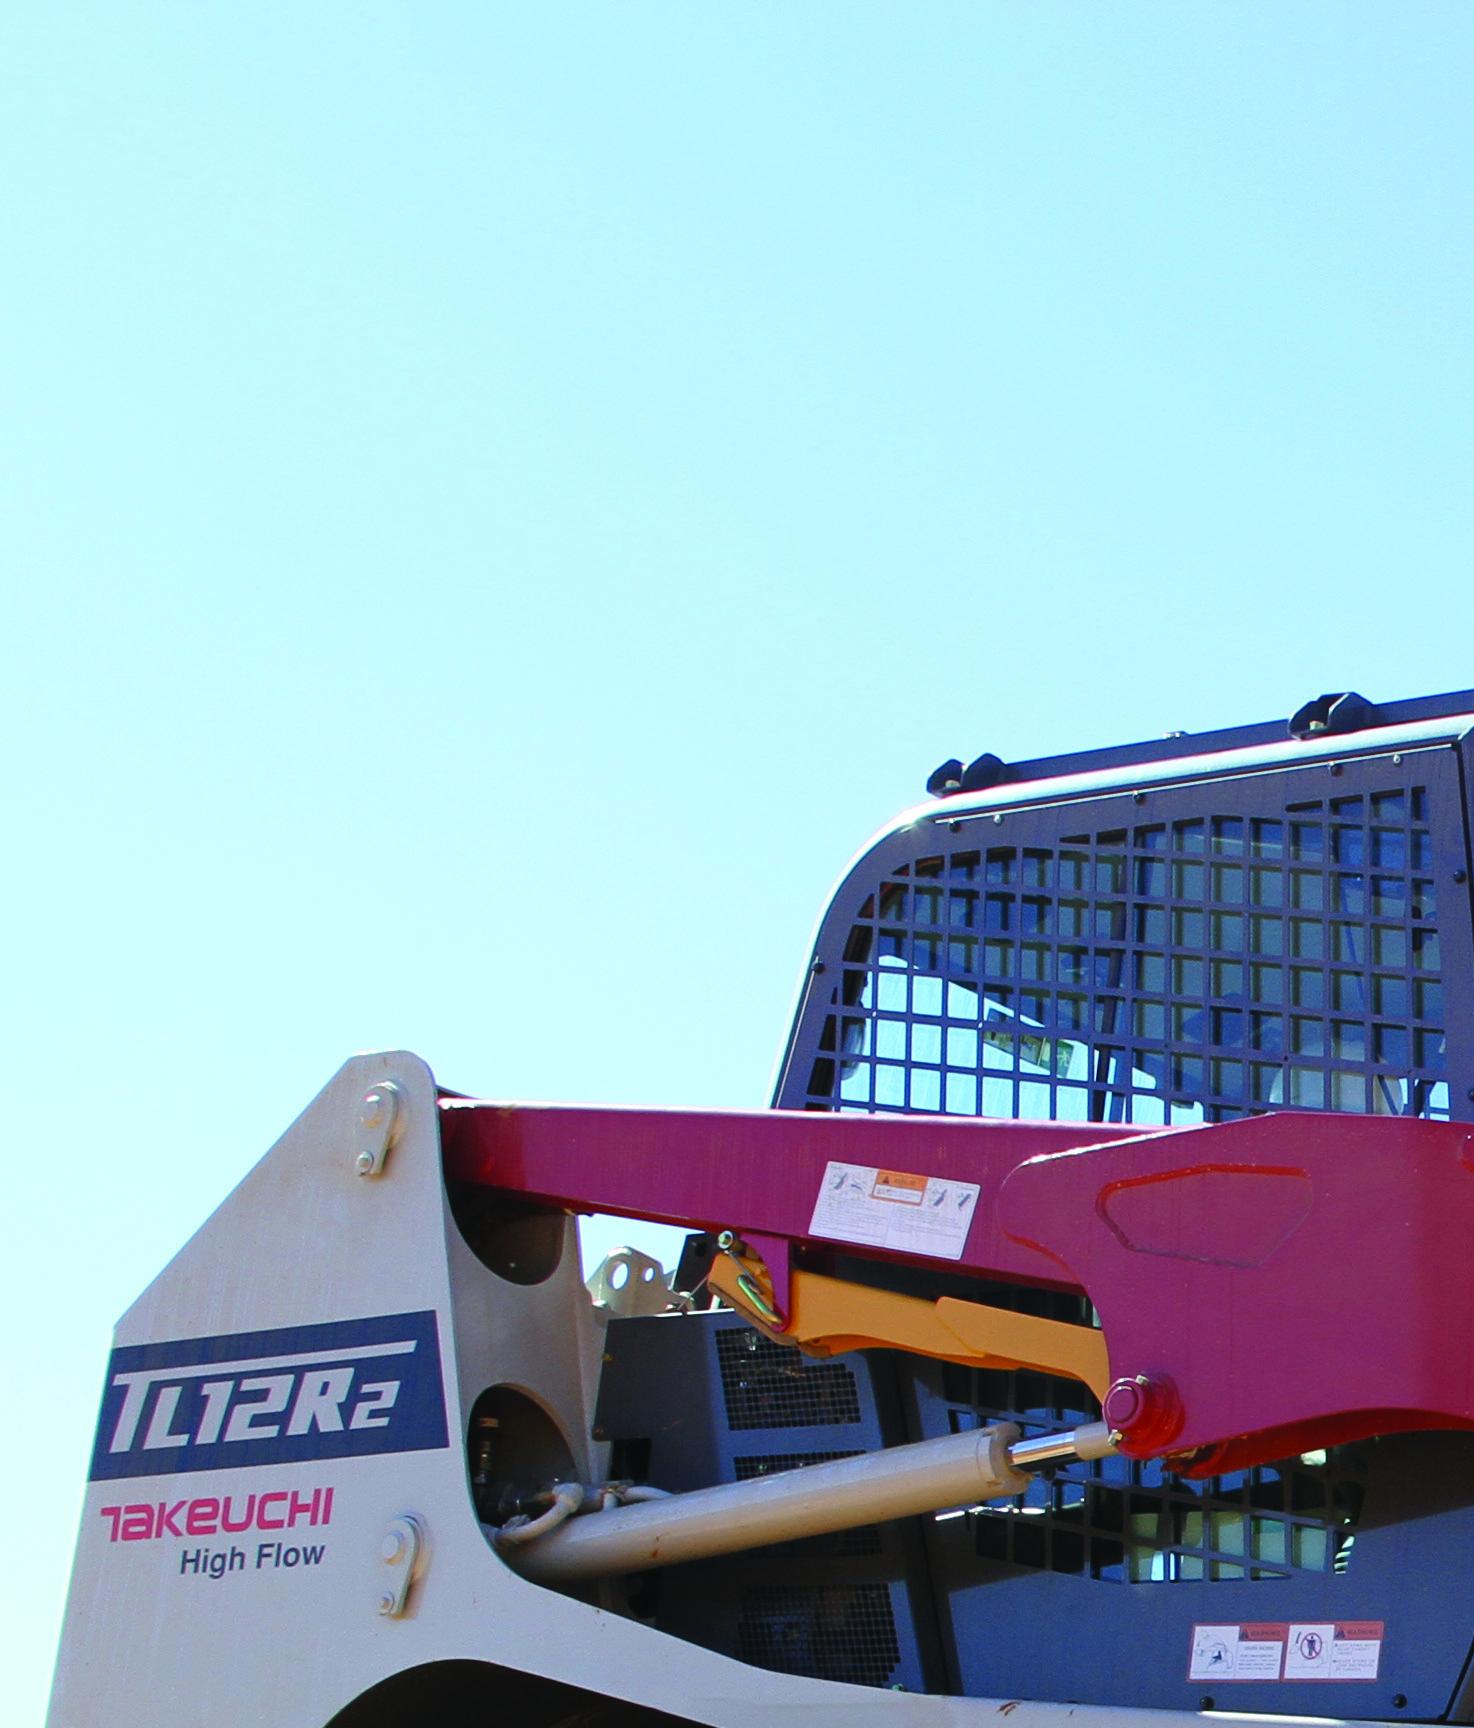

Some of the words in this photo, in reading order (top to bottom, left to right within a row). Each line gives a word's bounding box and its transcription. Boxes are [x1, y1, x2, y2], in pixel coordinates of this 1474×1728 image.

[108, 1340, 417, 1454] TL12R2
[100, 1487, 335, 1543] TAKEUCHI
[180, 1545, 245, 1579] High
[256, 1541, 326, 1569] Flow
